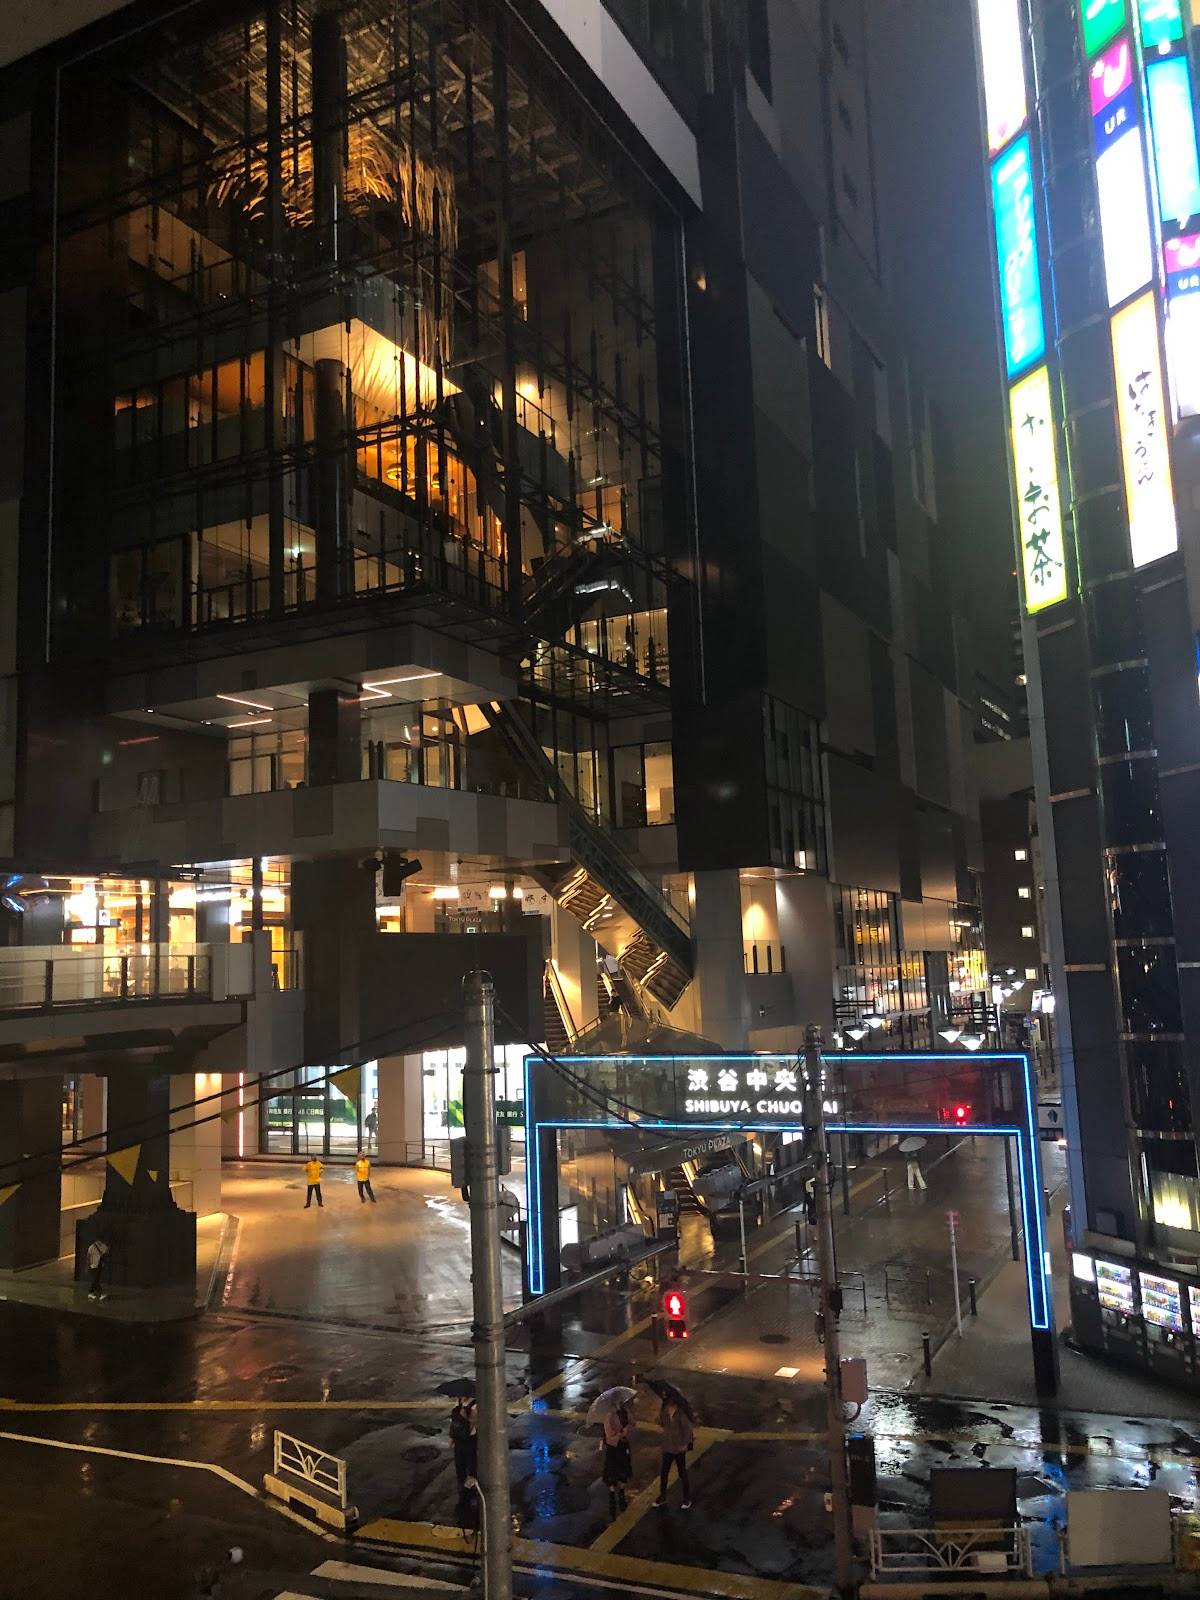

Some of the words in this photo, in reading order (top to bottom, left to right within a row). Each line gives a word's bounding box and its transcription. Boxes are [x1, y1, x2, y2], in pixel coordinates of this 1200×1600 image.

[1104, 107, 1128, 135] UR
[1177, 274, 1200, 291] UR
[685, 1099, 751, 1113] SHIBUYA
[683, 1143, 707, 1158] TOKYU
[707, 1136, 731, 1152] PLAZA
